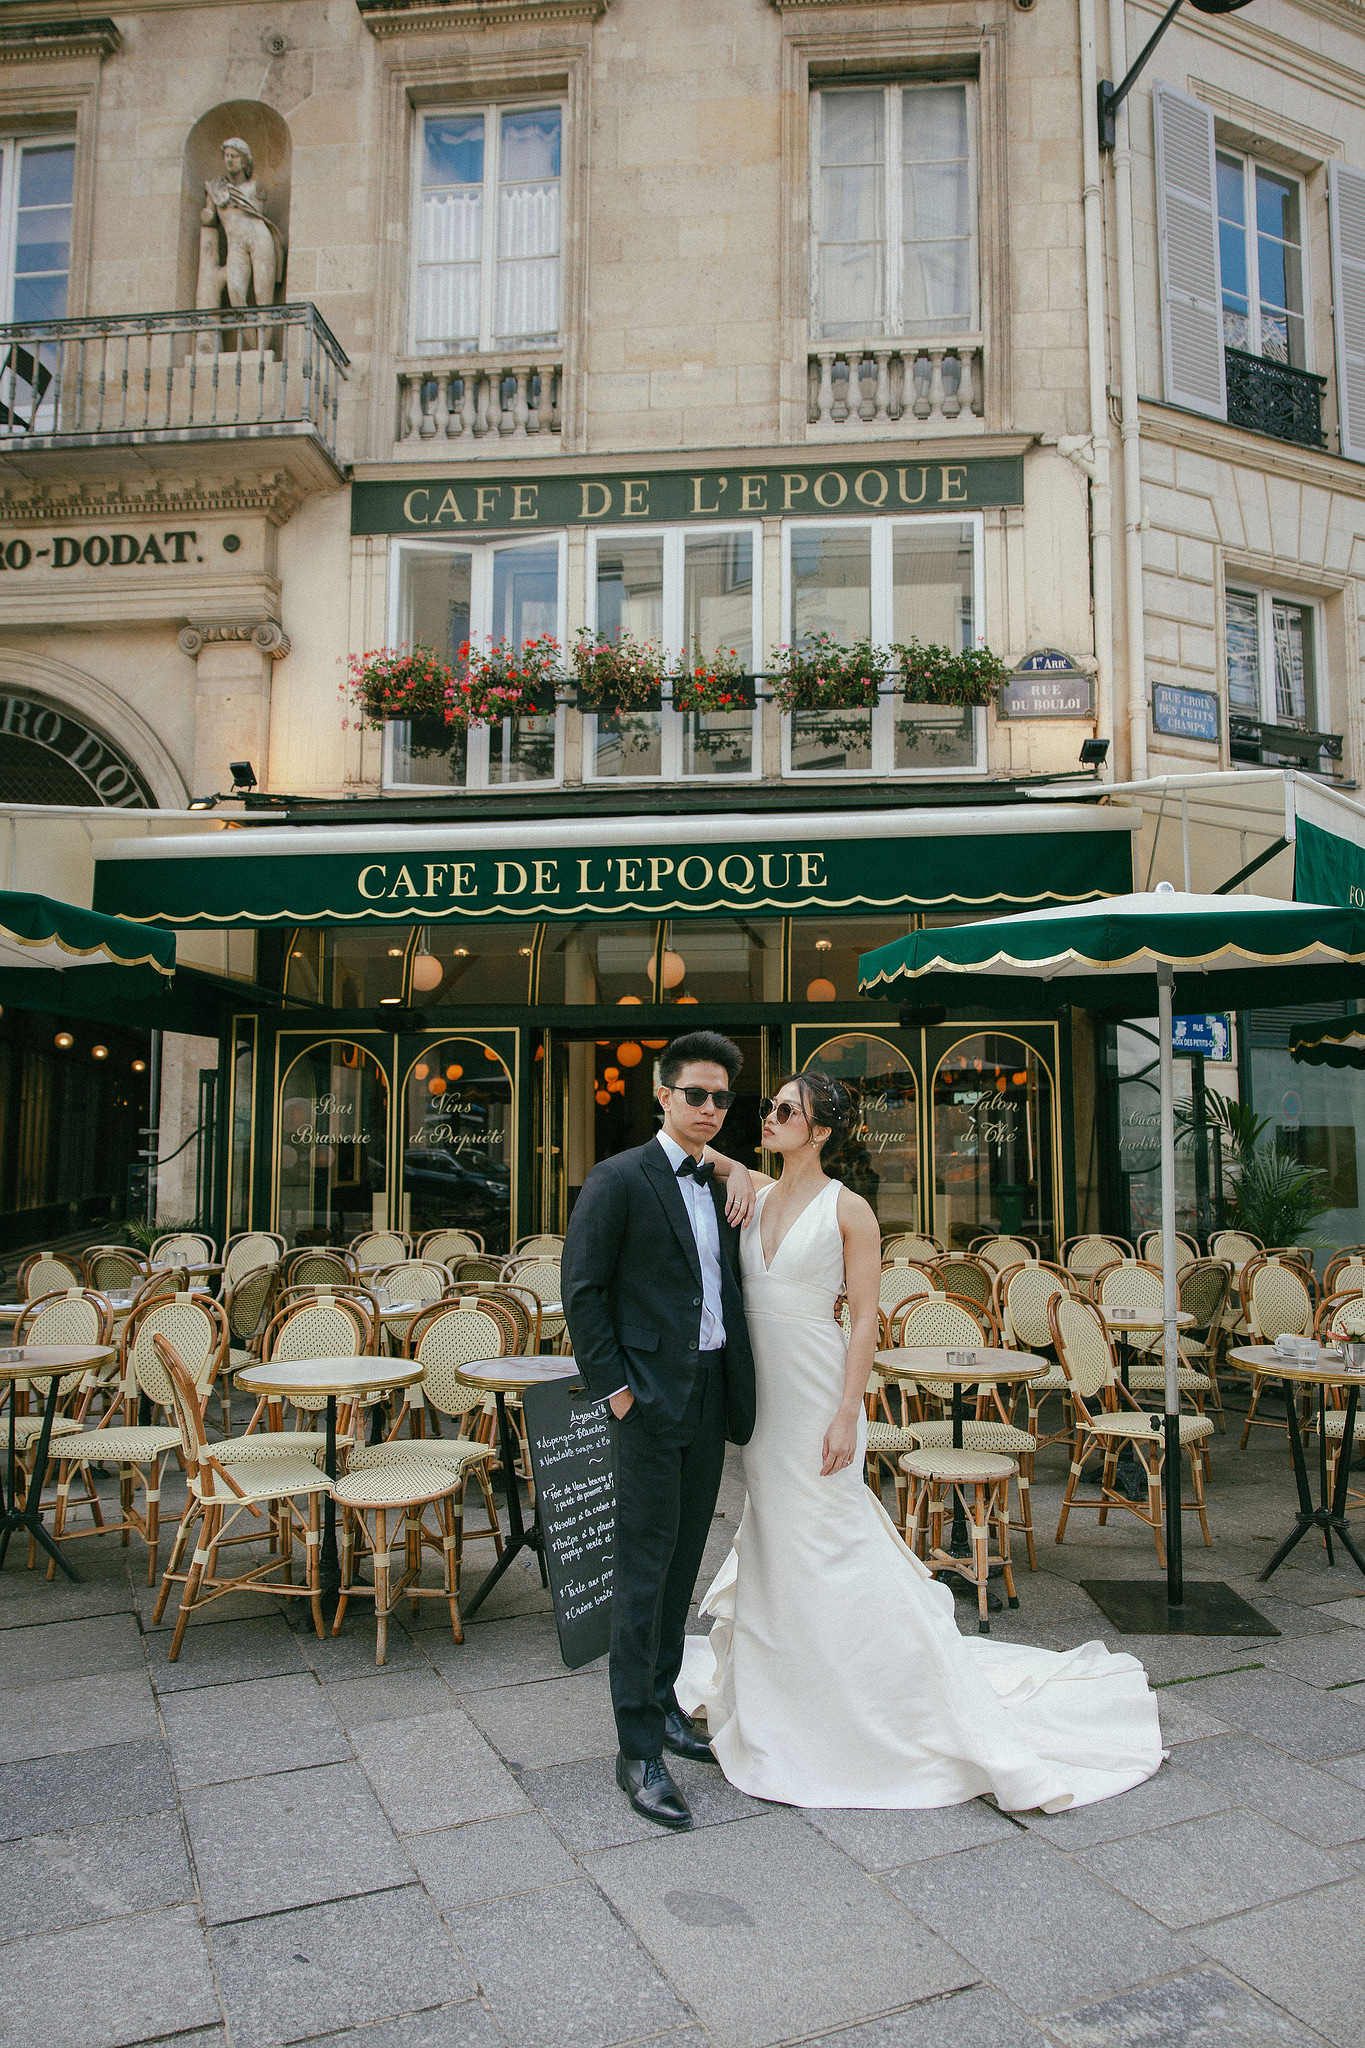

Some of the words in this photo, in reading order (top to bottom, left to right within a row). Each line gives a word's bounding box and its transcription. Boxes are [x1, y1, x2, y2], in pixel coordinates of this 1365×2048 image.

[403, 484, 539, 524] CAFE
[577, 480, 650, 518] DE
[690, 465, 968, 513] L'EPOQUE
[1031, 684, 1061, 696] RUE
[1161, 690, 1181, 703] RUE
[1183, 695, 1210, 709] CROIX
[1011, 700, 1029, 711] DU
[1034, 698, 1081, 710] BOULOI
[1159, 702, 1178, 715] DES
[1180, 707, 1214, 722] PETITS
[357, 862, 478, 899] CAFE
[492, 860, 560, 895] DE
[575, 852, 828, 894] L'EPOQUE
[1349, 885, 1365, 908] FO
[1192, 1023, 1204, 1032] RUE
[1184, 1038, 1193, 1047] DES
[315, 1093, 353, 1115] Bar
[431, 1092, 472, 1114] Vins
[959, 1090, 1020, 1115] Salon
[290, 1123, 371, 1144] Brasserie
[409, 1127, 426, 1143] de
[429, 1123, 506, 1155] Propriété
[960, 1124, 978, 1142] de
[980, 1121, 1018, 1143] Thé
[541, 1435, 576, 1451] Asperges
[575, 1443, 594, 1454] soupe
[564, 1484, 572, 1495] de
[576, 1492, 584, 1502] de
[603, 1481, 611, 1491] de
[553, 1516, 577, 1532] Risotto
[584, 1508, 592, 1518] la
[556, 1535, 579, 1550] Poulpe
[588, 1526, 596, 1537] la
[585, 1537, 603, 1551] verte
[604, 1533, 612, 1543] et
[565, 1579, 587, 1598] Tarte
[587, 1577, 600, 1588] aux
[570, 1602, 594, 1619] Crème
